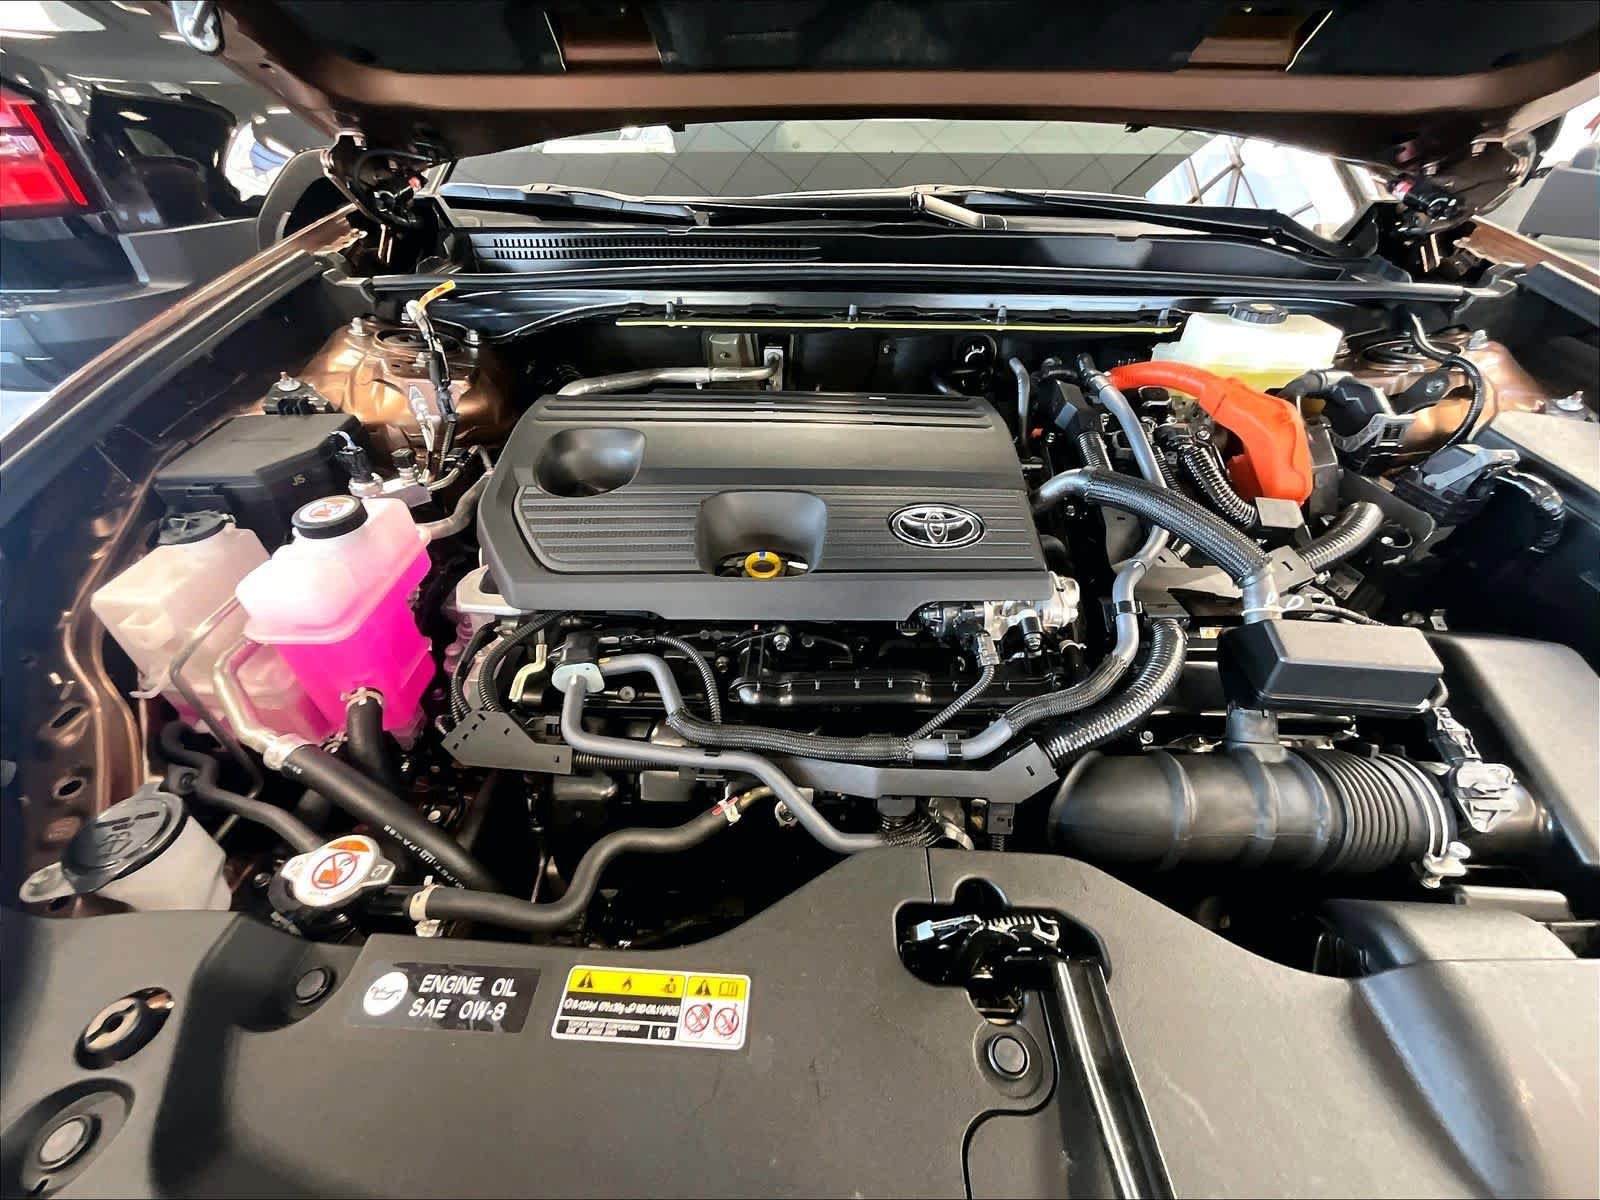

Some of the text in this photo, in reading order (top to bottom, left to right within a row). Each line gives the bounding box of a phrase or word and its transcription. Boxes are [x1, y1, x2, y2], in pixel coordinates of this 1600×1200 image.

[418, 974, 518, 997] ENGINE OIL
[408, 998, 508, 1021] SAE 0W-8
